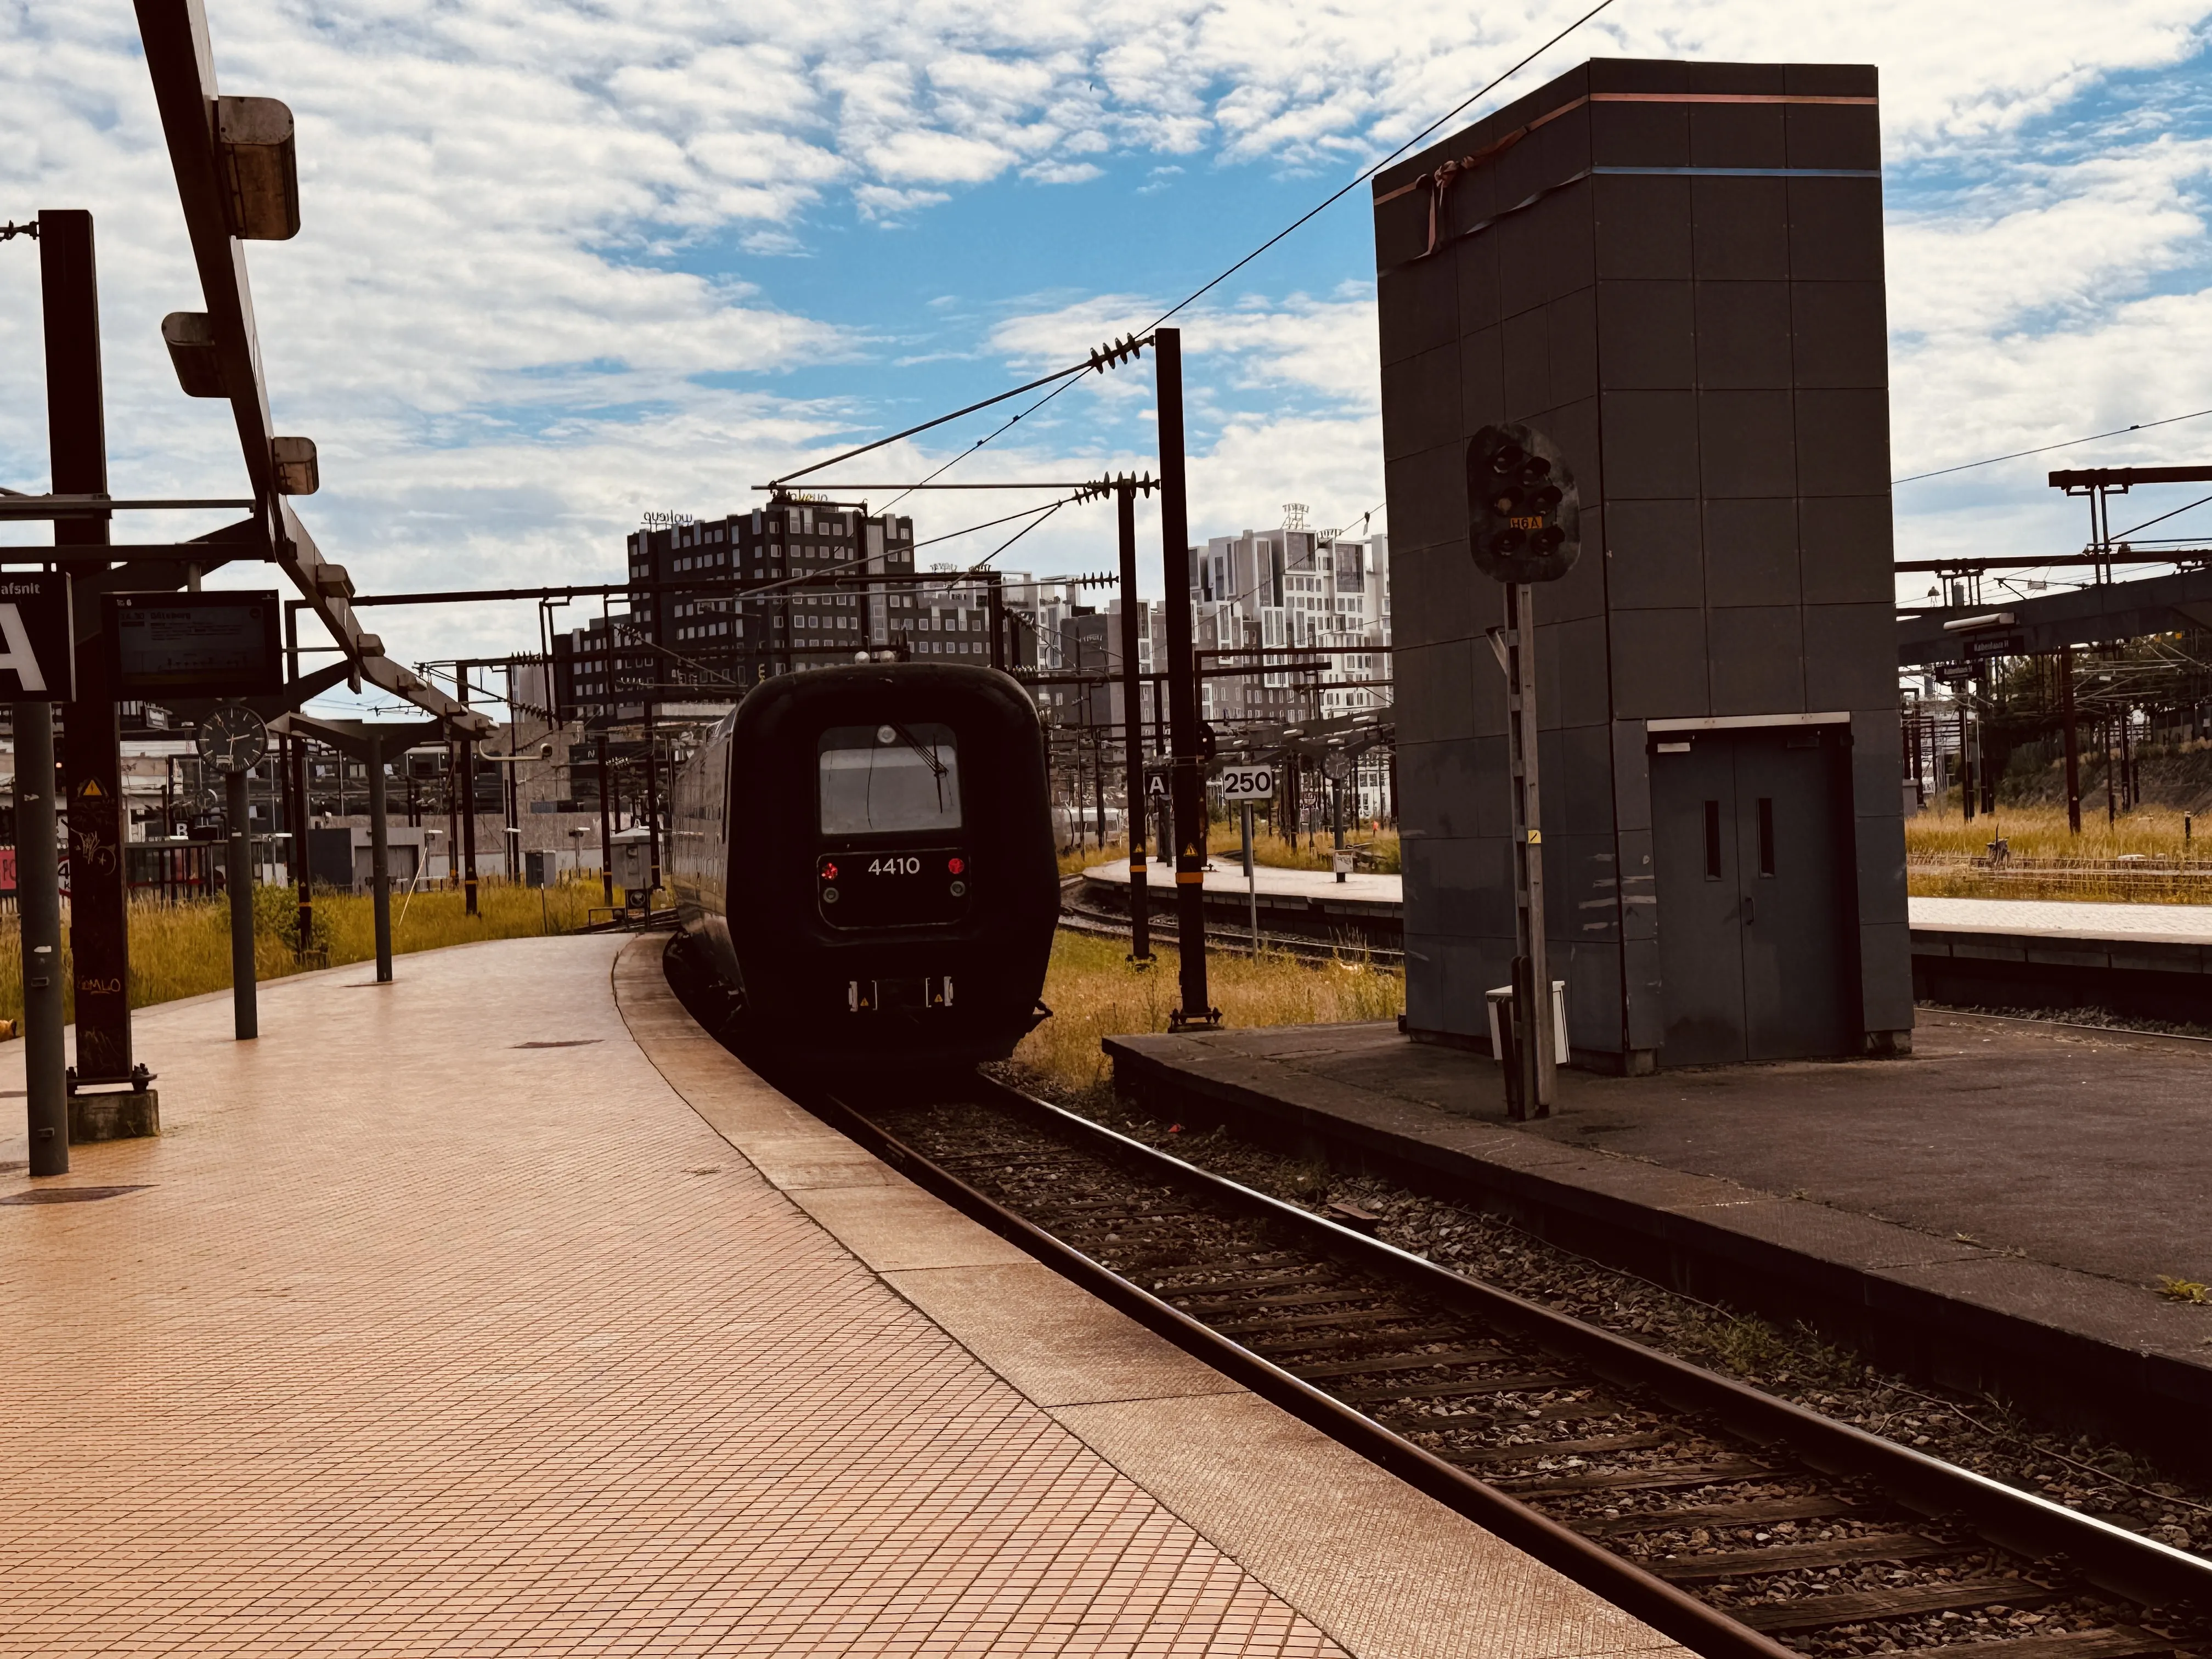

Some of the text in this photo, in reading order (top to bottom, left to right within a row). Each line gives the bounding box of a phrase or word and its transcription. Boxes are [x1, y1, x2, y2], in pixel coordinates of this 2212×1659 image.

[1, 583, 41, 595] afsnit
[1149, 776, 1165, 793] A
[1224, 771, 1271, 793] 250
[176, 823, 188, 836] B
[868, 857, 920, 876] 4410
